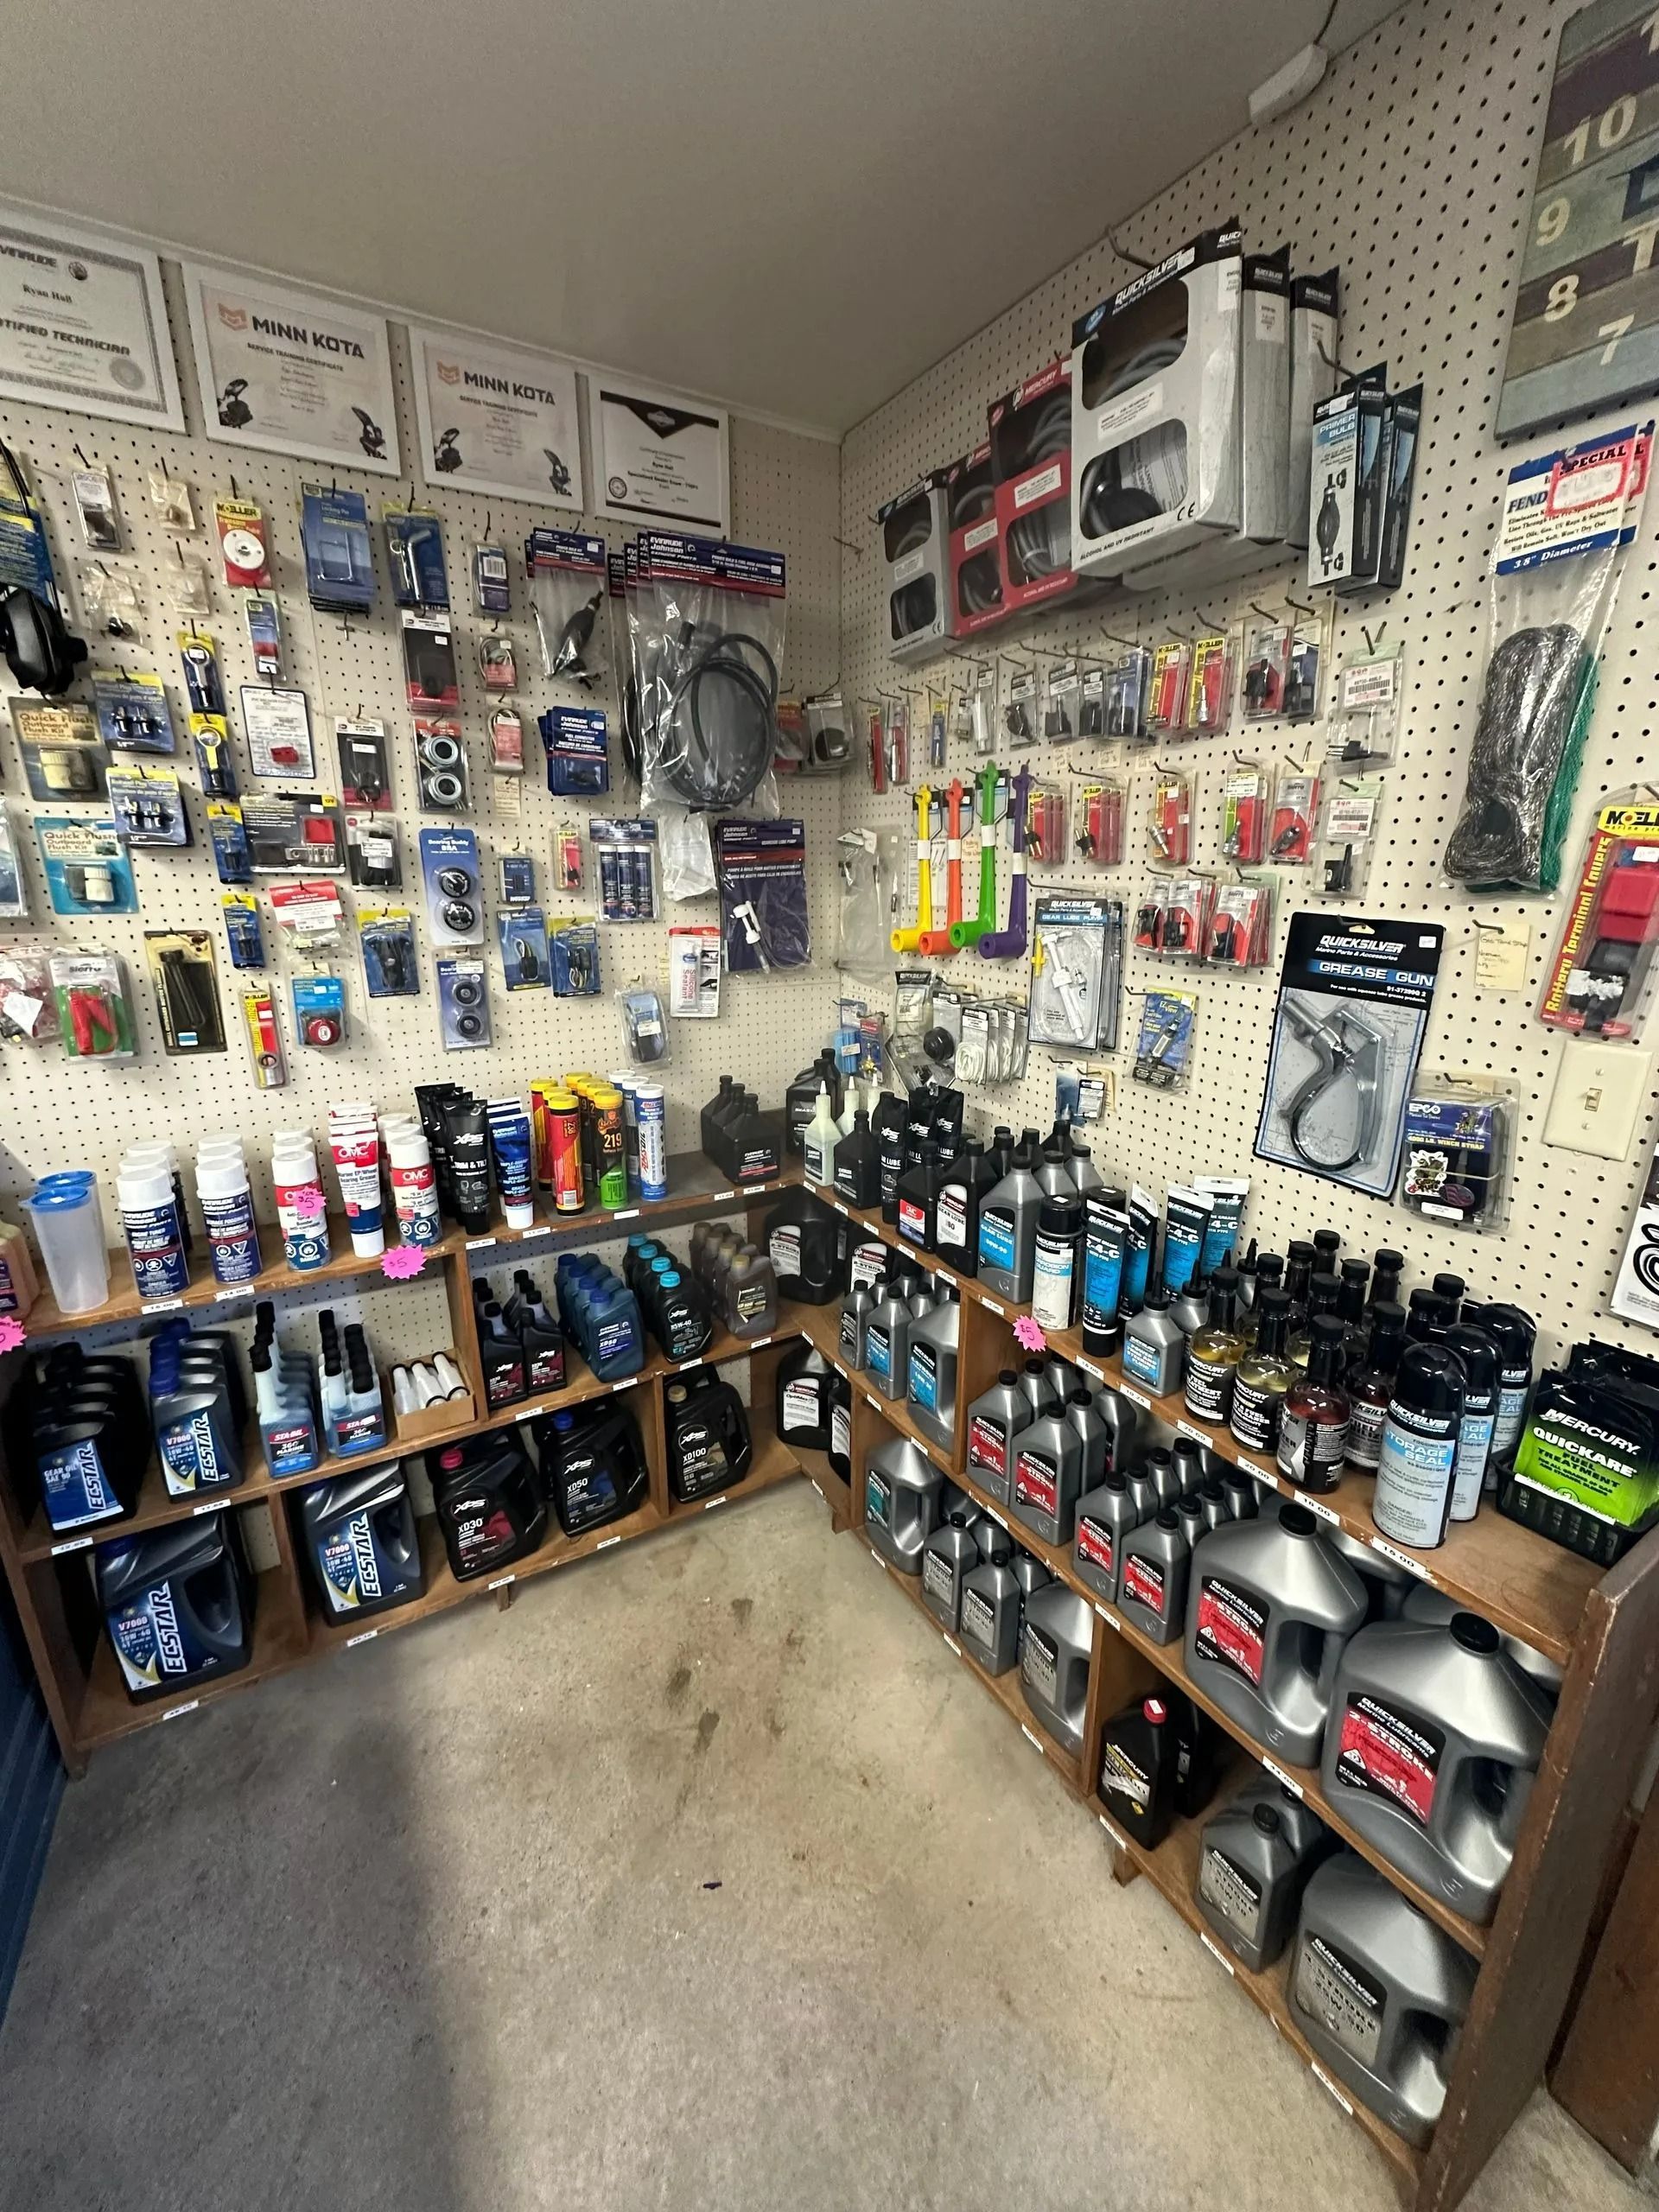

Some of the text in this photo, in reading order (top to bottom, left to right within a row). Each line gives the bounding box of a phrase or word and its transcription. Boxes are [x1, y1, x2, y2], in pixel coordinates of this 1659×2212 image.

[1563, 94, 1637, 166] 10
[1536, 198, 1570, 246] 9
[1544, 274, 1580, 321] 8
[251, 315, 365, 359] MINN KOTA
[1598, 314, 1636, 365] 7
[464, 371, 556, 406] MINN KOTA
[1319, 413, 1356, 434] PRIMER
[1507, 490, 1549, 514] FEND
[650, 543, 683, 555] Johnson
[1541, 540, 1592, 562] Diameter
[20, 712, 58, 723] Quick
[22, 721, 69, 729] Outboard
[1315, 946, 1336, 955] Marine
[1360, 951, 1398, 962] Accessories
[1319, 934, 1404, 954] QUICKSILVER
[1319, 961, 1434, 988] GREASE GUN
[1408, 1103, 1441, 1115] EPCO
[454, 1133, 485, 1145] XPS
[604, 1132, 623, 1147] 219
[338, 1147, 368, 1158] OMC
[639, 1132, 650, 1173] AMSOIL
[886, 1156, 901, 1167] LUBE
[402, 1168, 429, 1181] OMC
[1389, 1399, 1452, 1429] QUICKSILVER
[680, 1431, 707, 1445] XPS
[1546, 1408, 1642, 1456] MERCURY
[192, 1411, 219, 1482] ECSTAR
[682, 1447, 707, 1464] XD100
[1404, 1450, 1447, 1466] SEAL
[1533, 1427, 1637, 1478] QUICKARE
[563, 1458, 593, 1474] XPS
[1537, 1447, 1620, 1489] TREATMENT
[1562, 1451, 1596, 1471] FUEL
[76, 1441, 107, 1510] ECSTAR
[566, 1478, 589, 1494] XD50
[454, 1498, 486, 1515] XPS
[457, 1519, 483, 1535] XD30
[349, 1511, 382, 1597] ECSTAR
[1211, 1580, 1264, 1624] QUICKSILVER
[118, 1616, 148, 1631] V7000
[148, 1580, 188, 1673] ECSTAR
[1203, 1592, 1262, 1648] 2-STROKE
[1357, 1702, 1430, 1758] Marine Lubricants
[1361, 1697, 1437, 1756] QUICKSILVER
[1349, 1710, 1434, 1783] 2-STROKE
[1213, 1849, 1259, 1900] QUICKSILVER
[1314, 1938, 1379, 2005] QUICKSILVER
